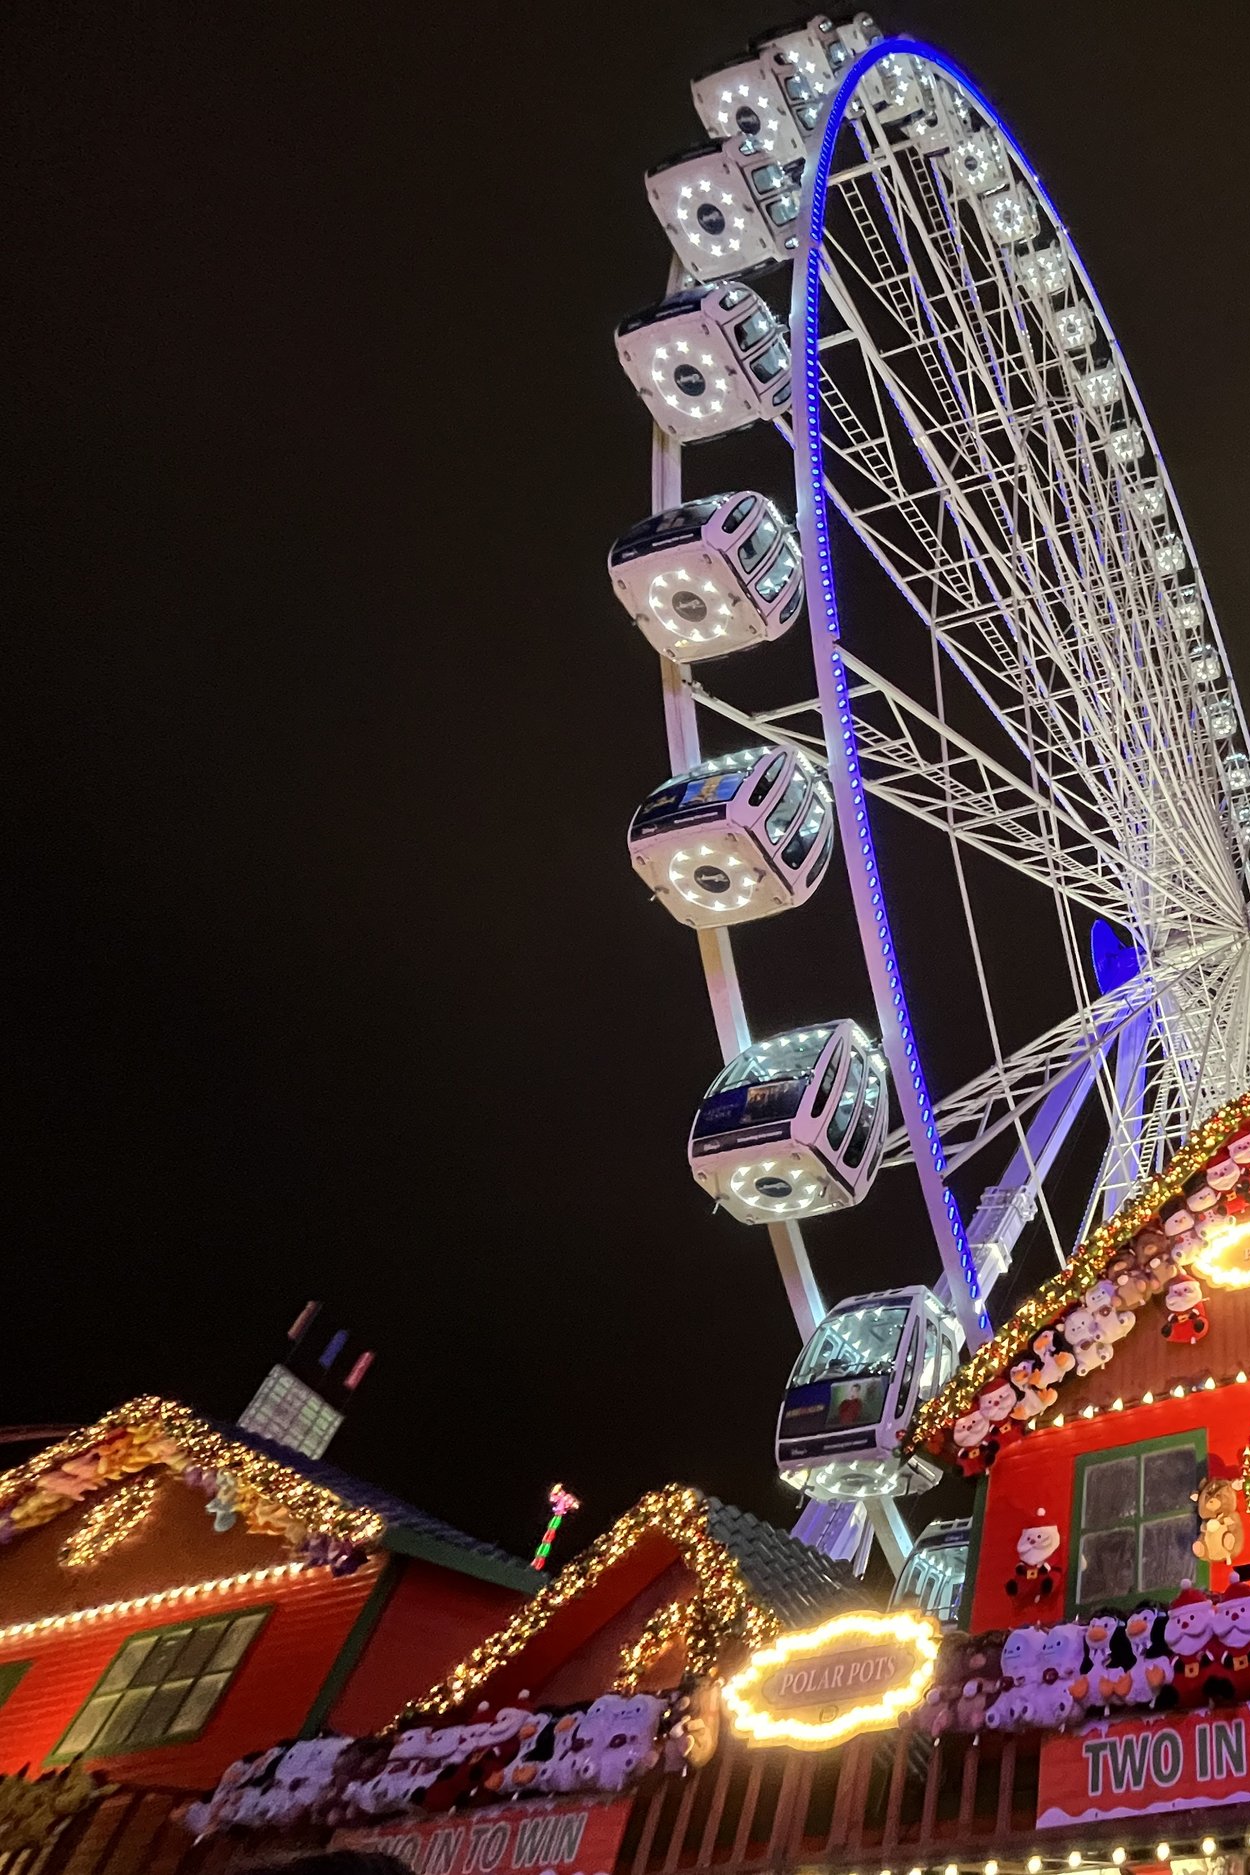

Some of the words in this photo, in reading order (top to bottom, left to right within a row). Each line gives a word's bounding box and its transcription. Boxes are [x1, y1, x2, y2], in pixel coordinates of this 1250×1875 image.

[778, 1663, 845, 1696] POLAR
[847, 1655, 898, 1686] POTS
[1083, 1729, 1182, 1797] TWO
[1195, 1718, 1248, 1782] IN
[462, 1822, 512, 1873] TO
[511, 1811, 589, 1869] WIN
